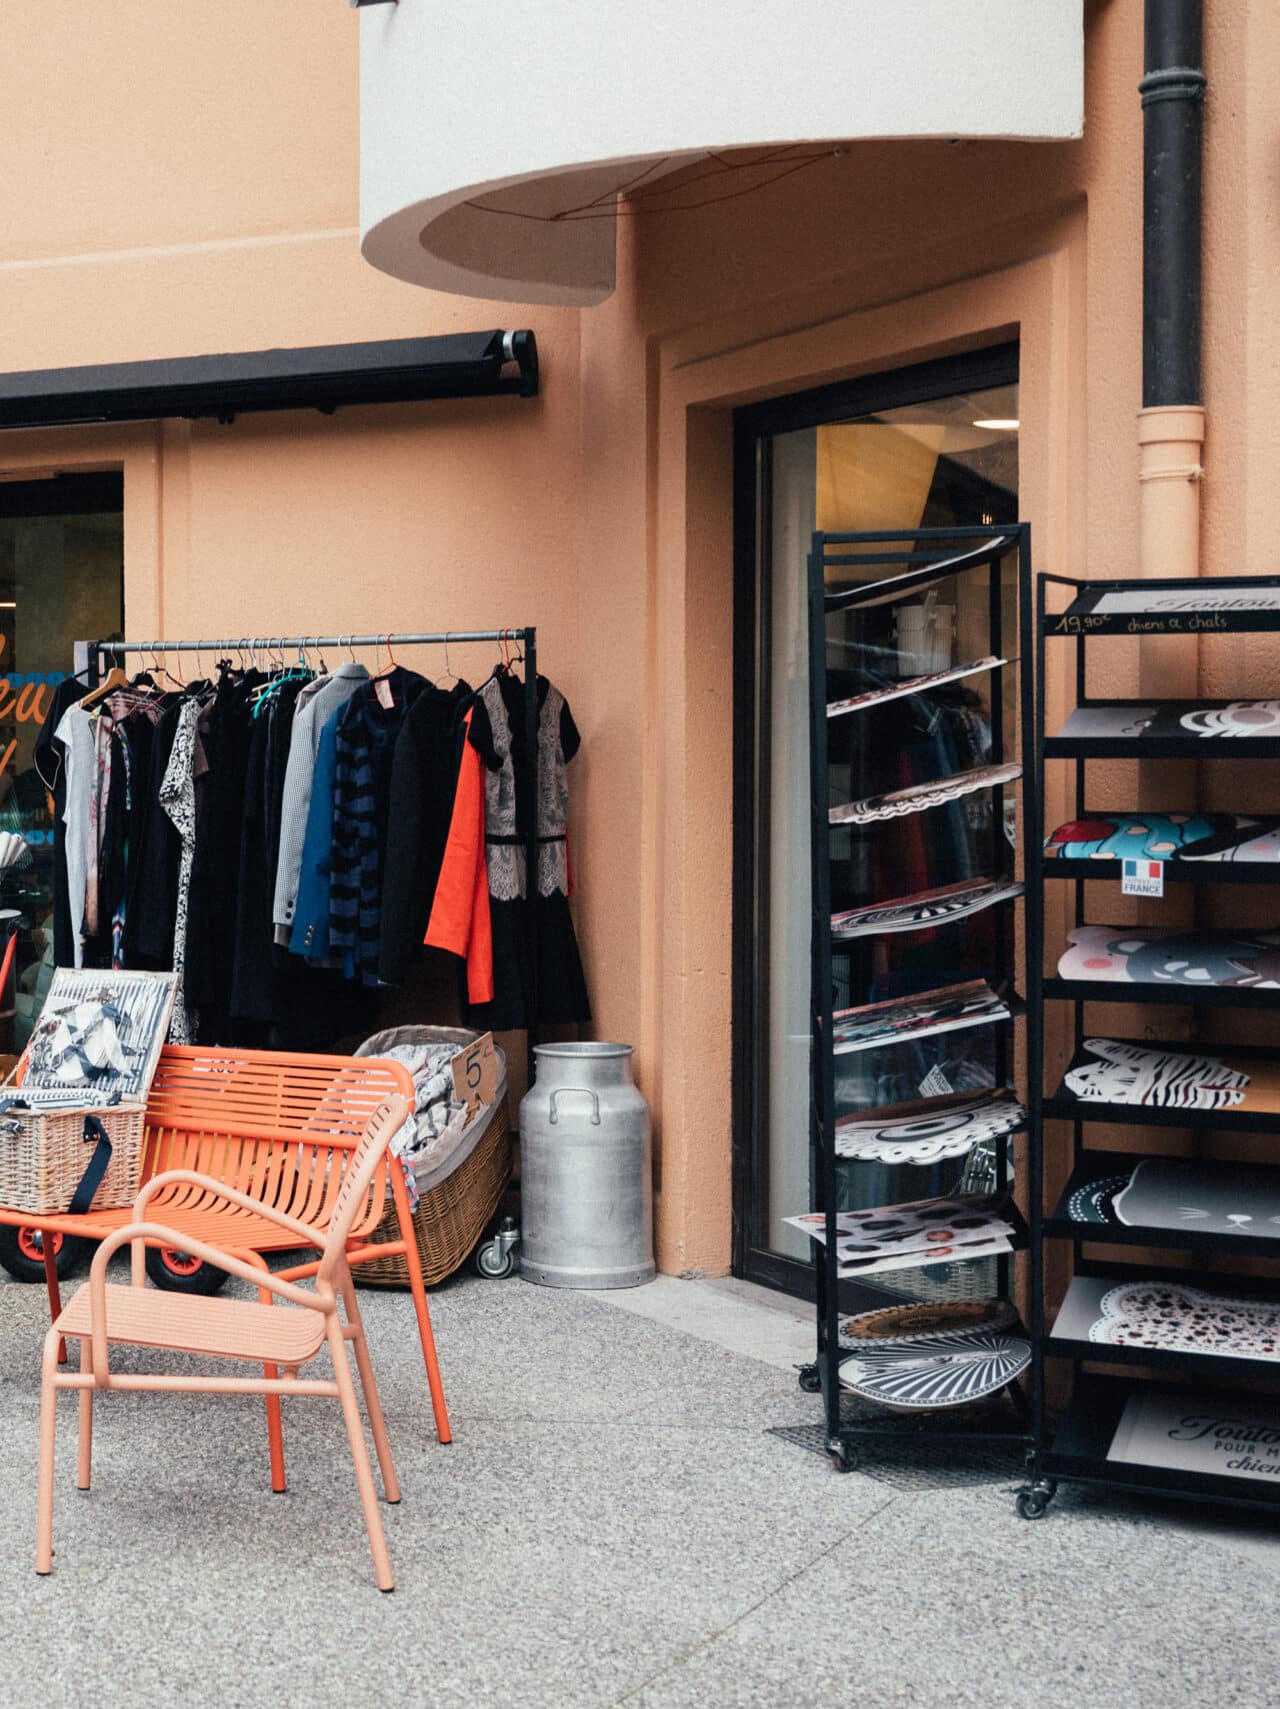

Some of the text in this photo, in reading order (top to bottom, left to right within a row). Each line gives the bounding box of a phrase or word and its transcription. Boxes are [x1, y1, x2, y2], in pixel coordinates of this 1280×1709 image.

[1188, 612, 1228, 629] chats
[1125, 884, 1160, 895] FRANCE
[1214, 1440, 1256, 1454] POUR
